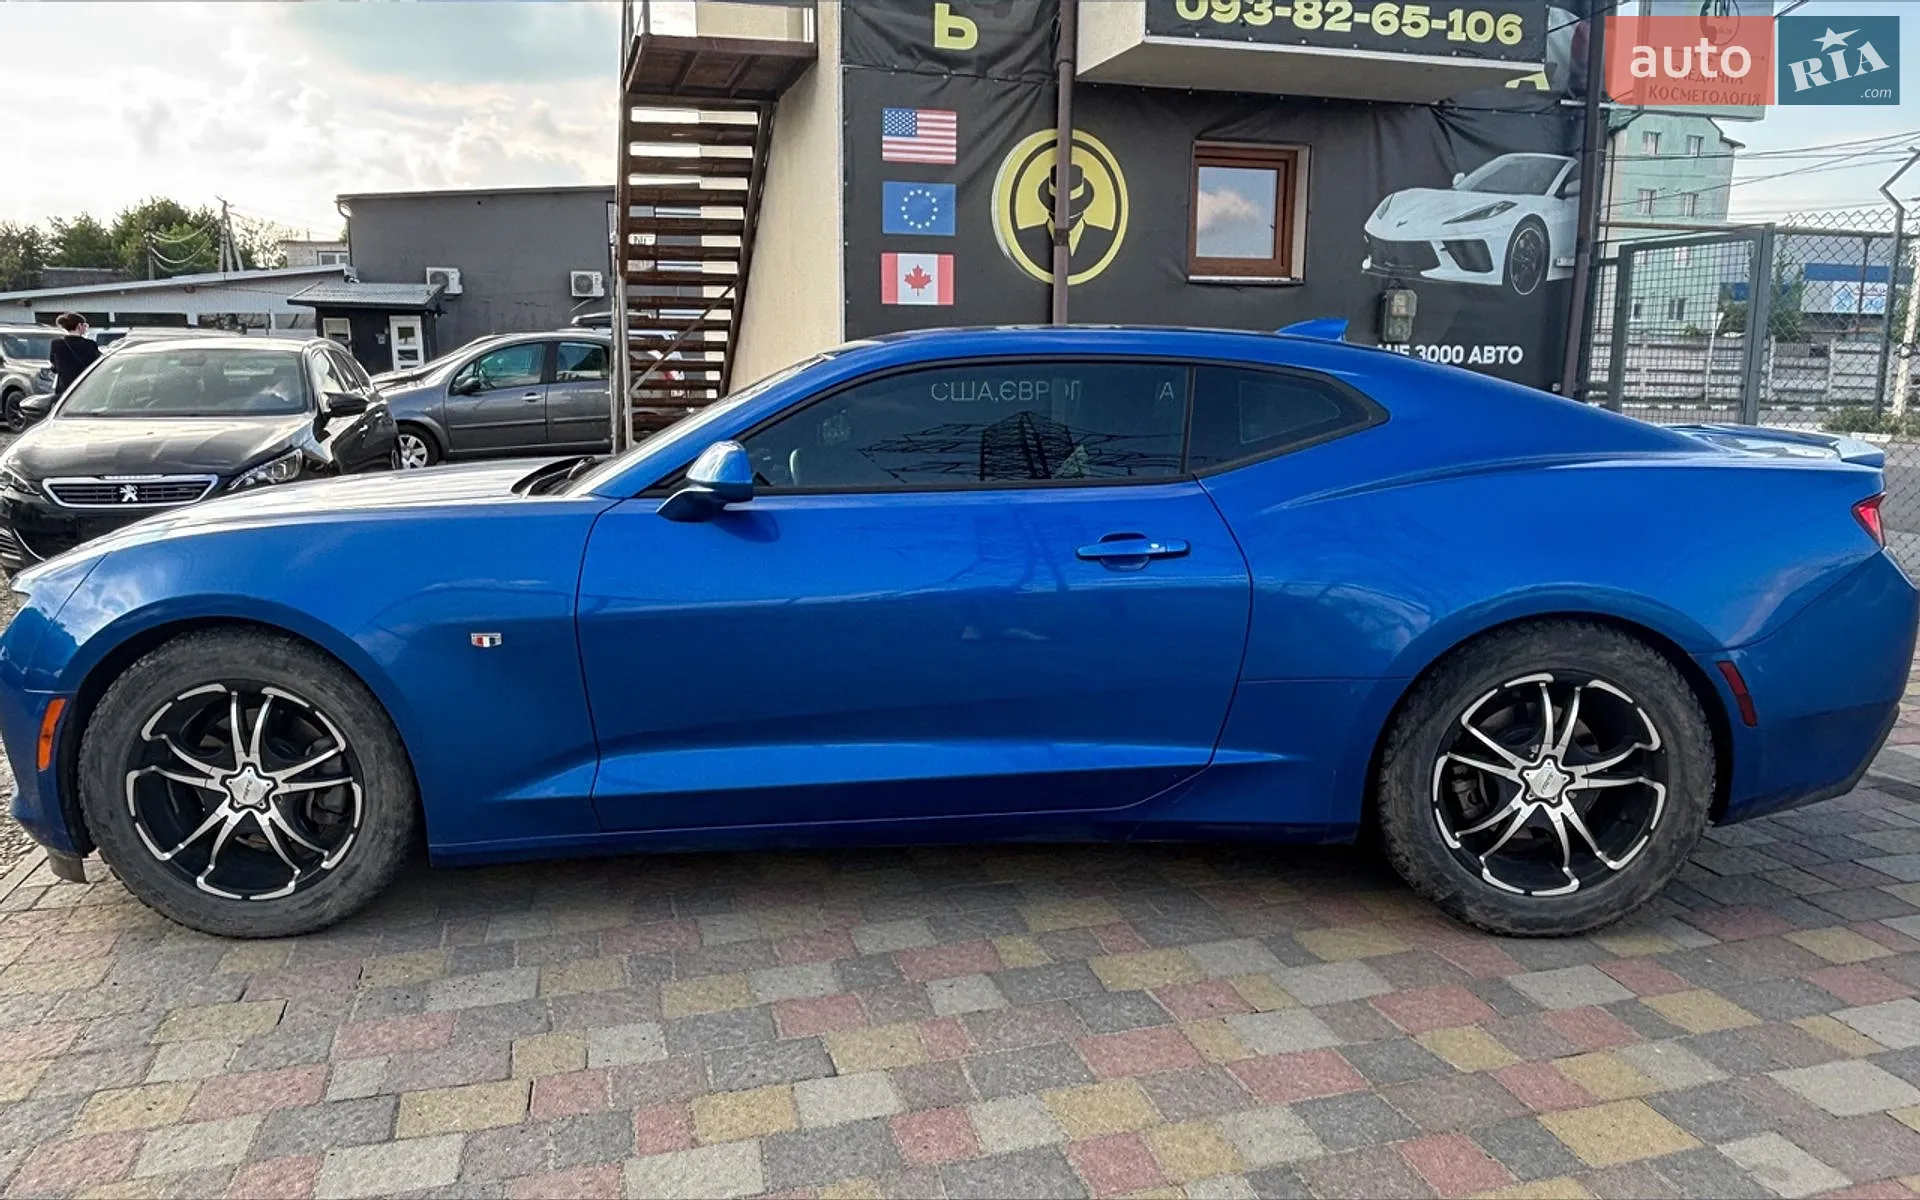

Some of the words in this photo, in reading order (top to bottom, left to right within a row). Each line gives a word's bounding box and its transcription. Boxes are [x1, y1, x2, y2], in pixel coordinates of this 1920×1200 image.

[1175, 0, 1524, 45] 093-82-65-106
[1415, 345, 1464, 364] 3000
[1468, 346, 1524, 365] АВТО
